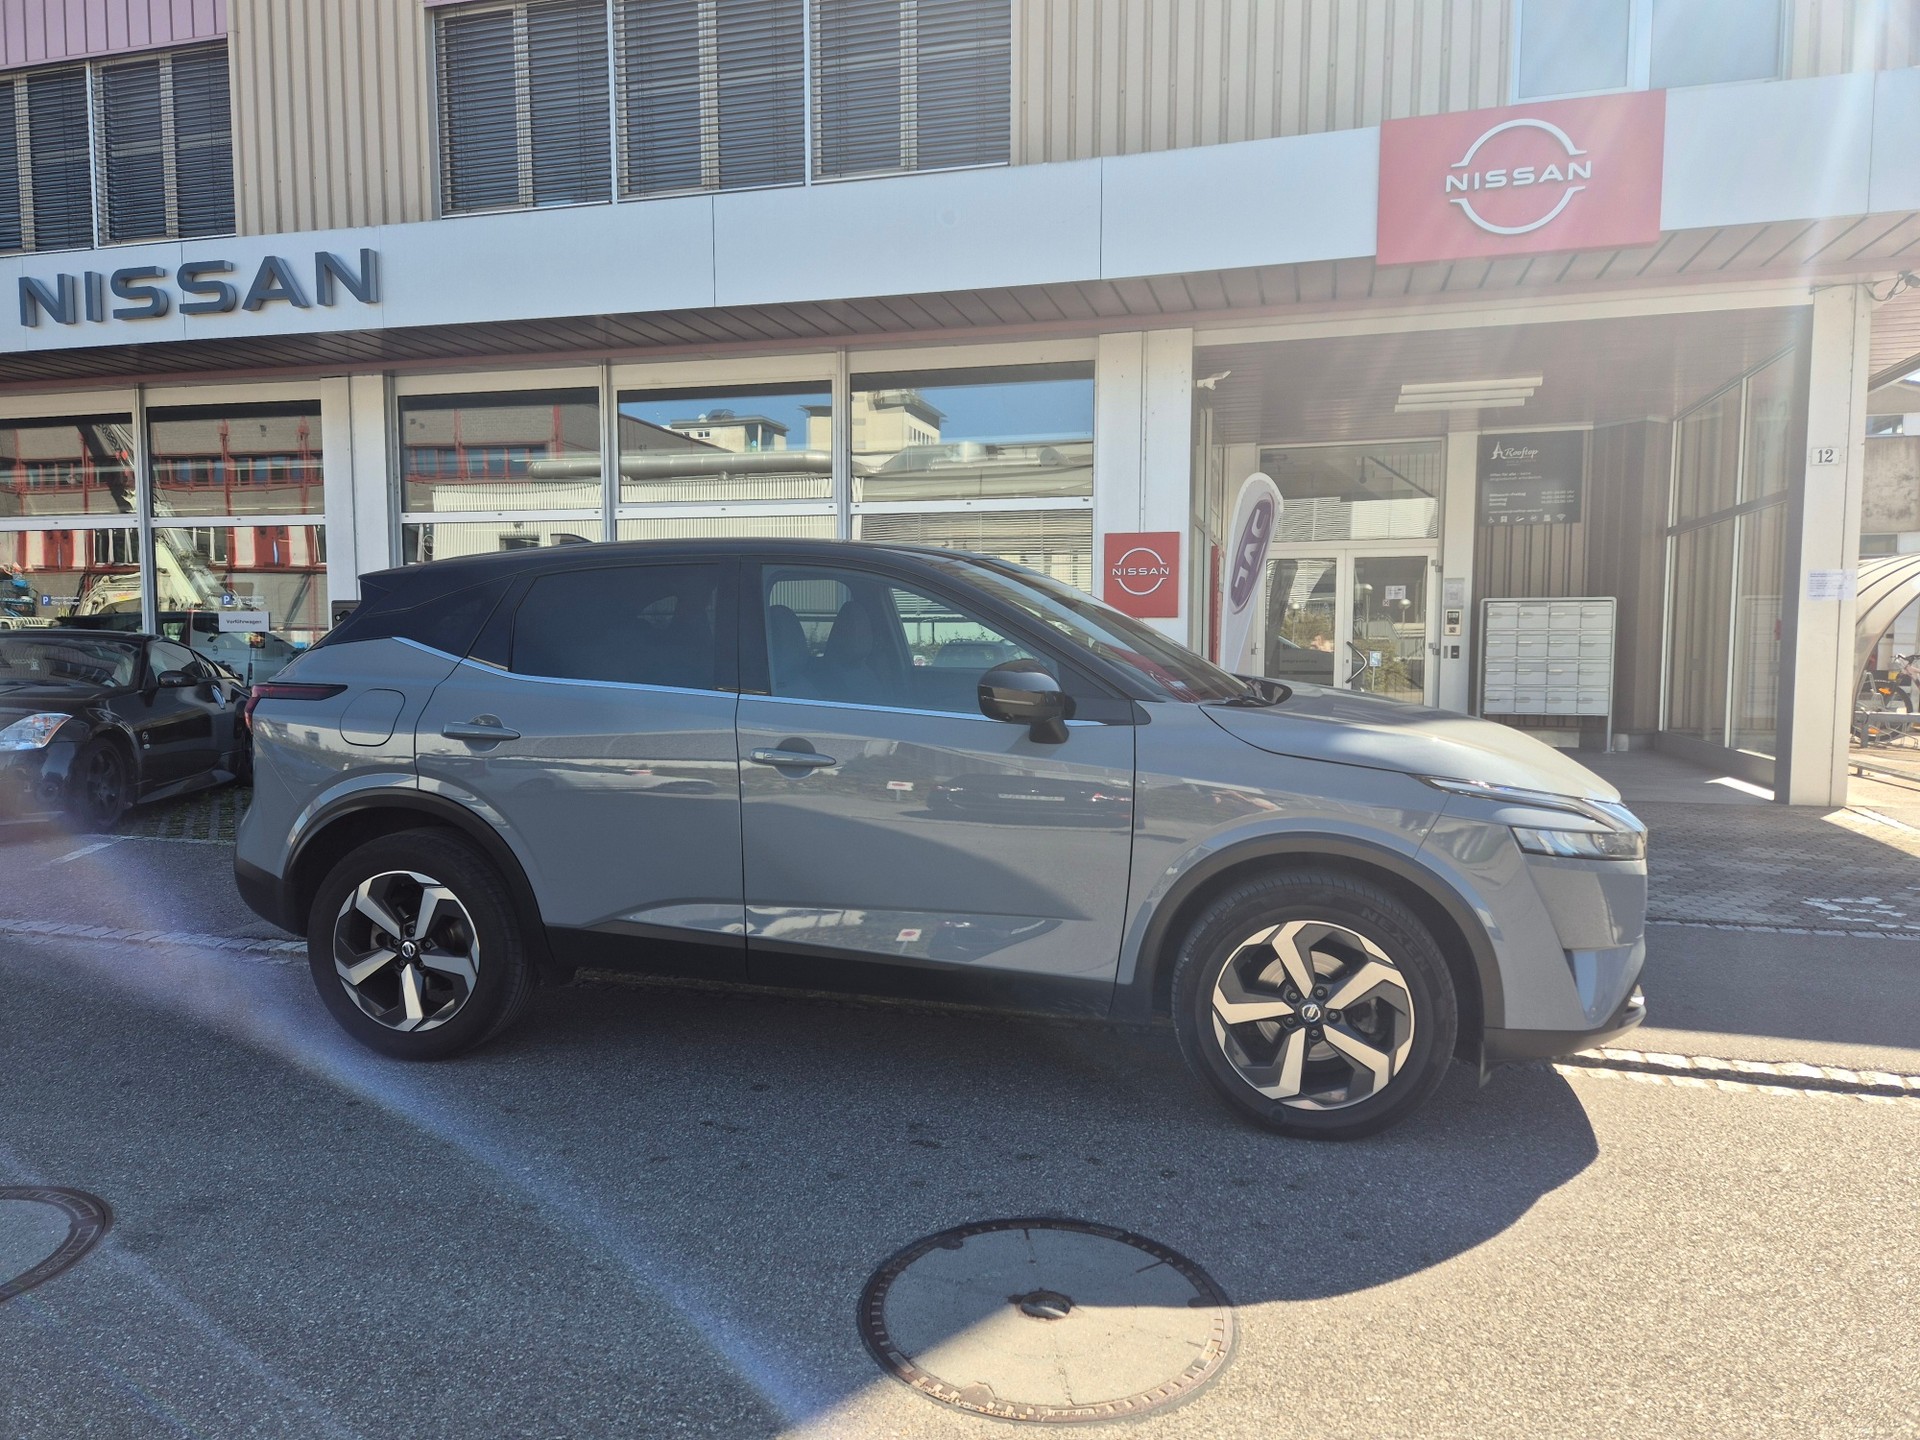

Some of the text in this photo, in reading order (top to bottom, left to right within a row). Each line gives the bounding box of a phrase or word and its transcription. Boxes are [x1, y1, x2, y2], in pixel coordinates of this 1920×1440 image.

[1445, 161, 1592, 193] NISSAN
[18, 248, 381, 328] NISSAN
[1505, 446, 1539, 459] Rooftop
[1818, 448, 1834, 463] 12
[1112, 567, 1170, 576] NISSAN
[42, 596, 49, 605] P
[223, 595, 230, 604] P
[1361, 907, 1430, 974] NEXEN
